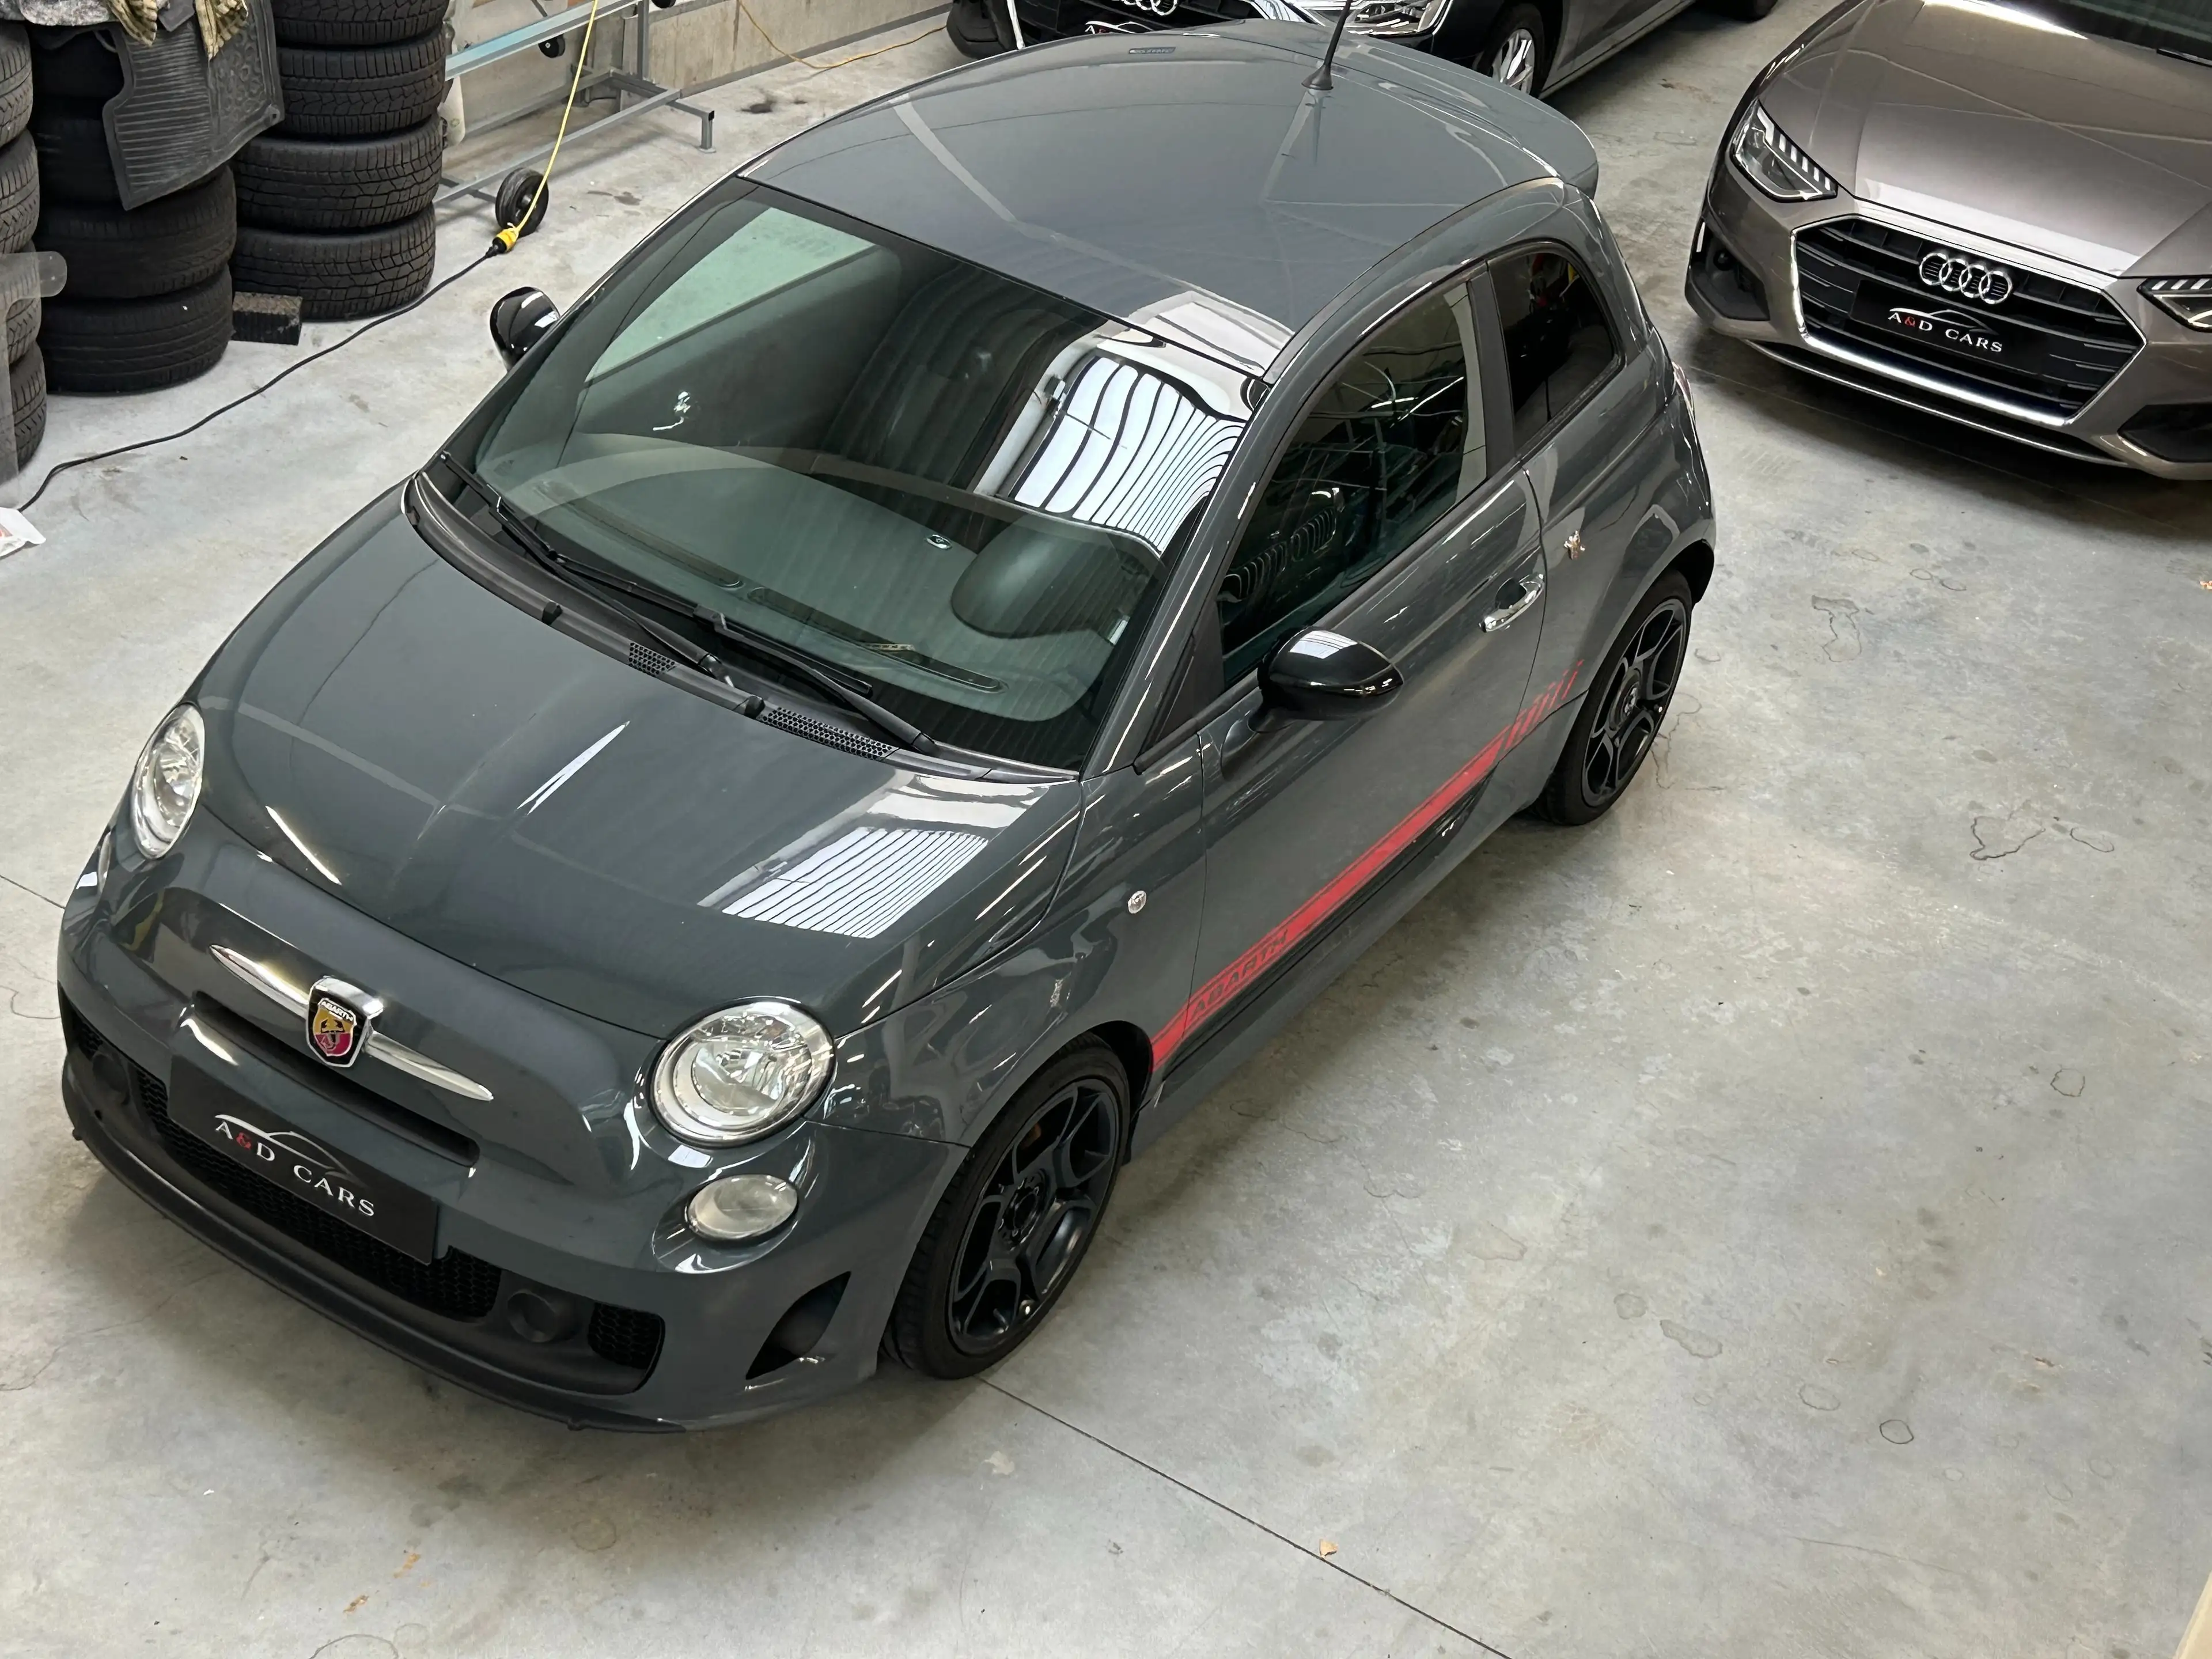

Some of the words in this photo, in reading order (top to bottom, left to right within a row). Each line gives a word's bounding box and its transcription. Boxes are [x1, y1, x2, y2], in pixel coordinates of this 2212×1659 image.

[1888, 312, 1933, 331] A&D
[1945, 328, 2003, 353] CARS
[1191, 929, 1288, 1020] ABARTH
[215, 1121, 276, 1161] A&D
[293, 1165, 375, 1217] CARS
